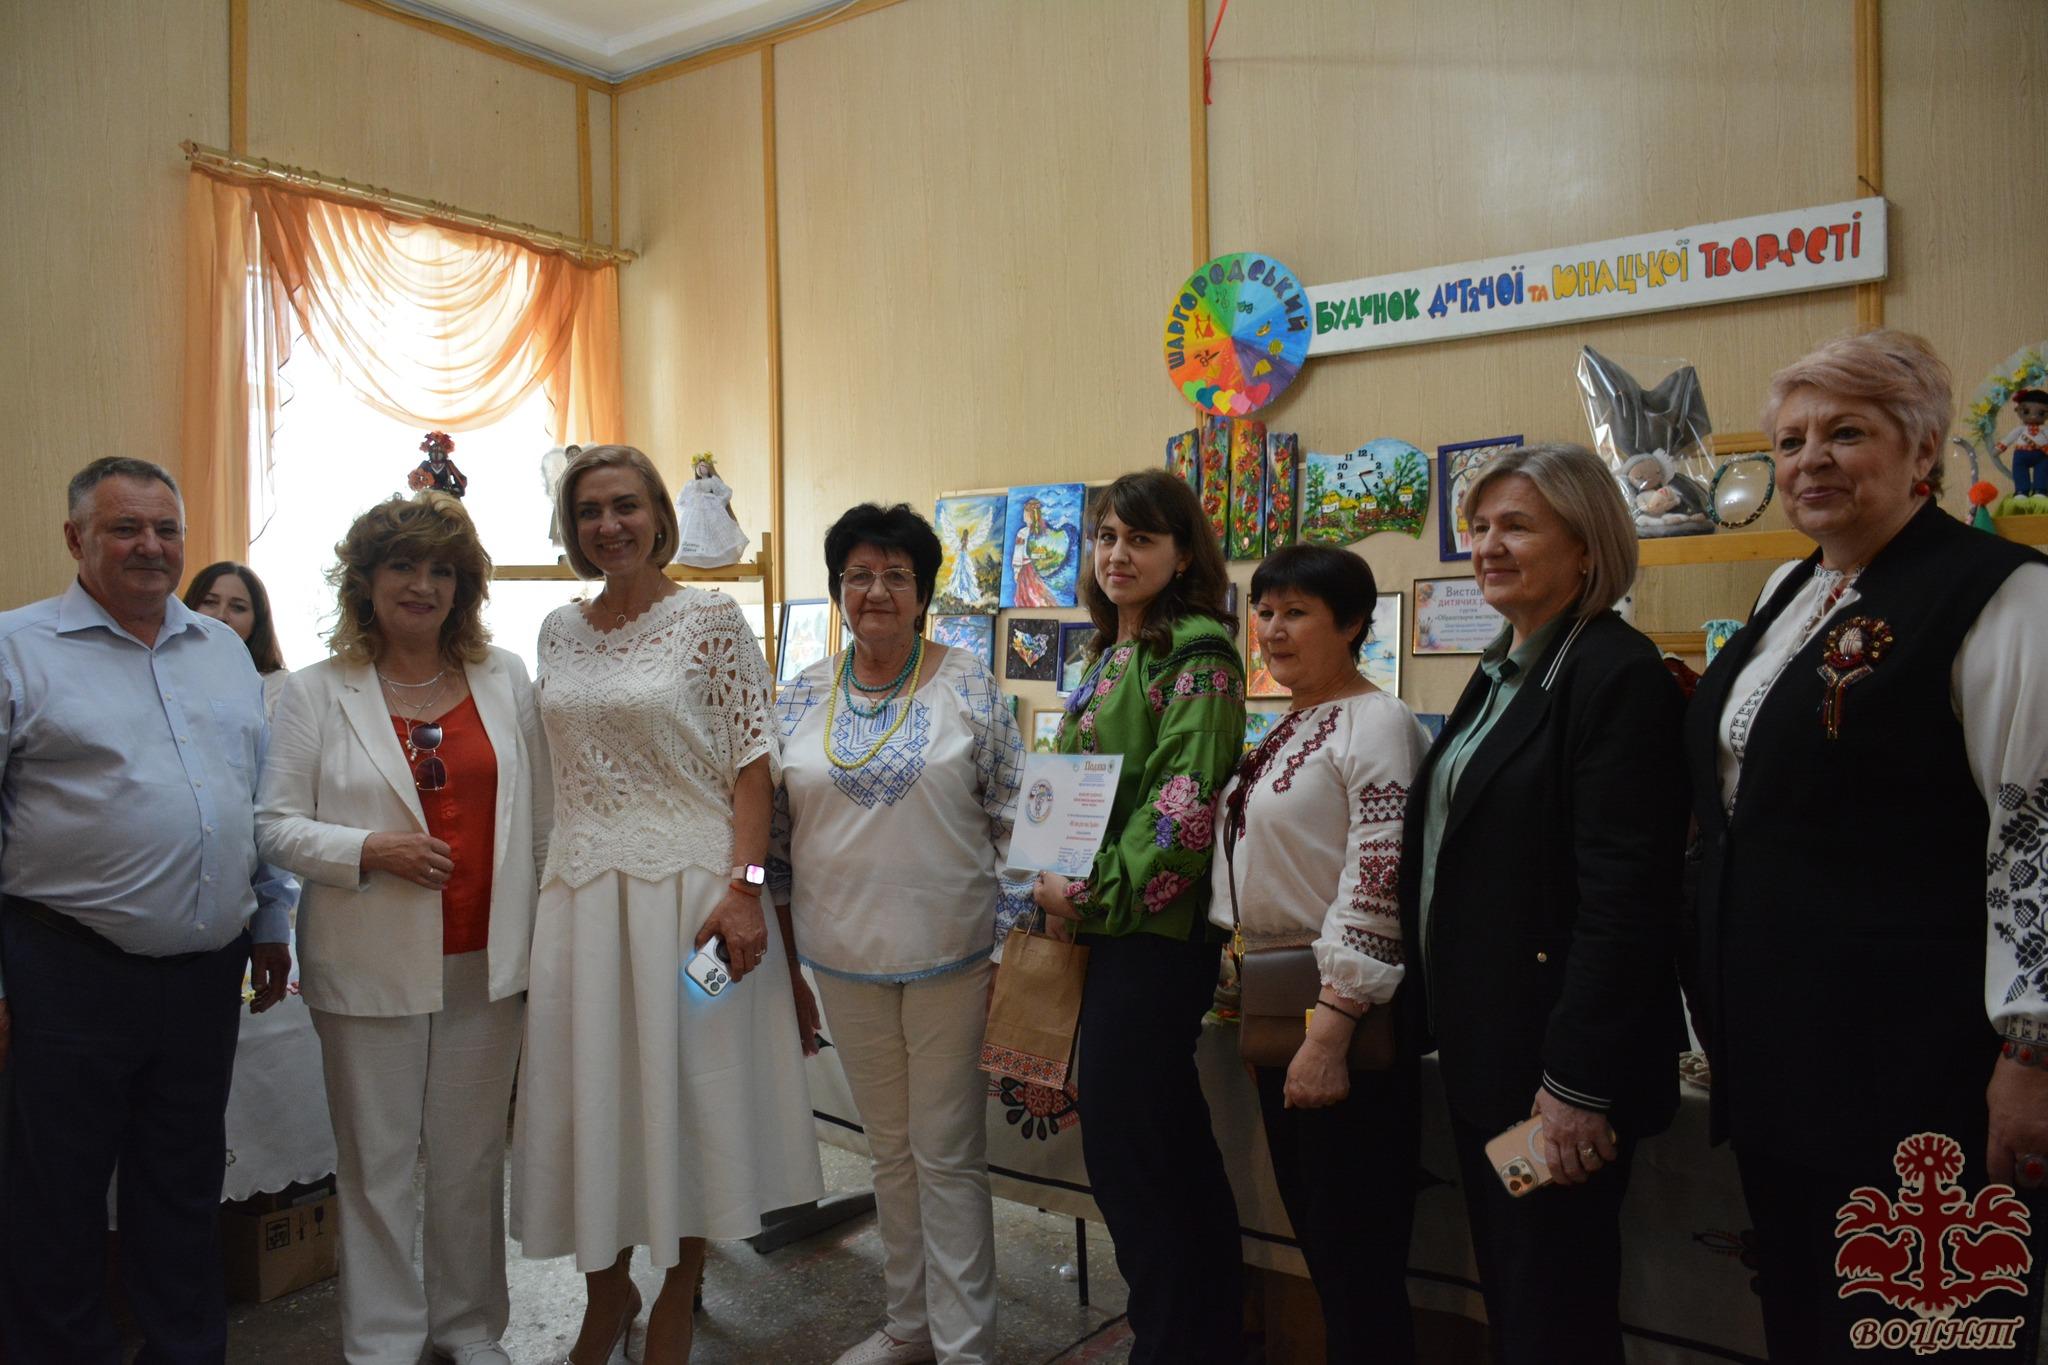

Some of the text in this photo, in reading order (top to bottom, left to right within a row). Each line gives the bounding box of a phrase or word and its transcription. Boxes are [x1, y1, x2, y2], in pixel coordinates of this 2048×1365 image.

[1316, 287, 1420, 335] БУДИНОК
[1427, 265, 1525, 319] ДИТЯЧОЇ
[1552, 238, 1690, 299] ЮНАЦЬКОЇ
[1167, 259, 1308, 369] ШАРГОРОДСЬКИЙ
[1345, 453, 1353, 461] 11
[1358, 449, 1367, 457] 12
[1370, 453, 1374, 461] 1
[1337, 462, 1348, 470] 10
[1375, 461, 1382, 469] 2
[1337, 472, 1343, 480] 9
[1377, 471, 1383, 479] 3
[1446, 586, 1482, 597] Вистав
